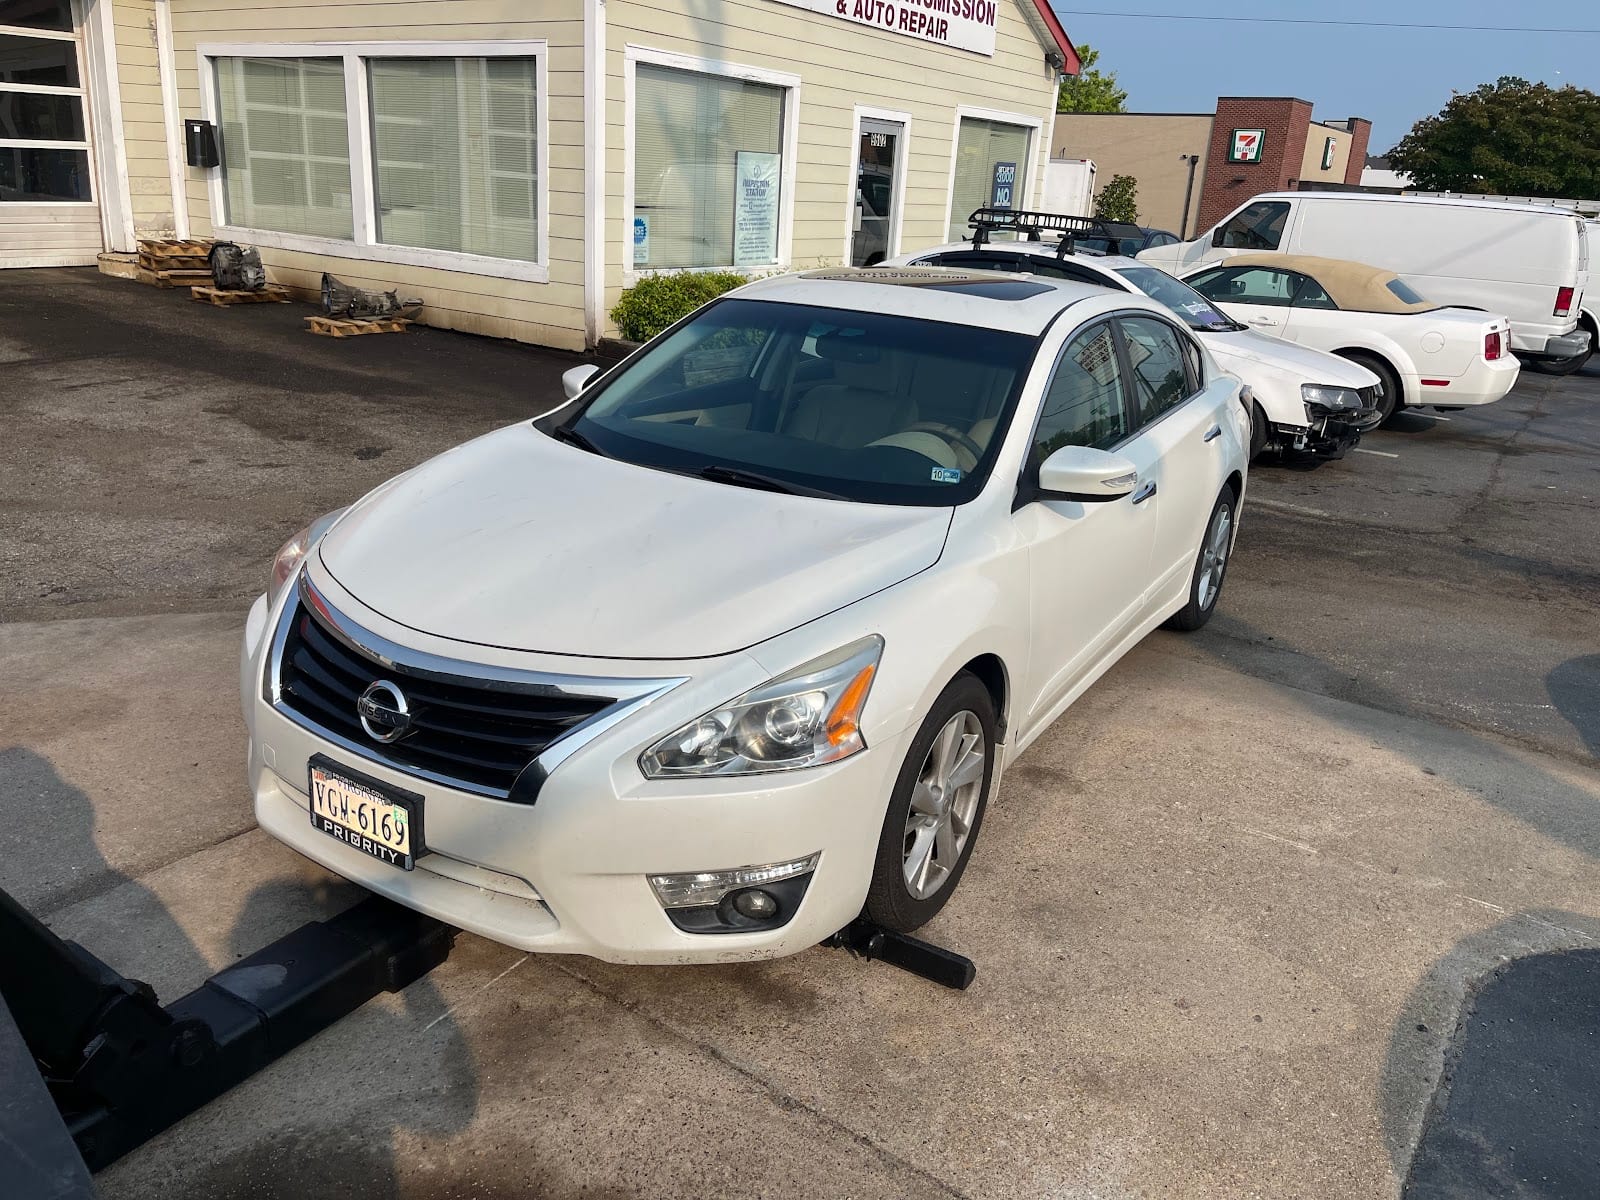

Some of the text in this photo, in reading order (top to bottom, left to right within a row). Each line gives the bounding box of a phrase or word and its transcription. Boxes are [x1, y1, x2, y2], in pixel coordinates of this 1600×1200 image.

[836, 0, 948, 41] & AUTO REPAIR
[933, 470, 943, 479] 10
[323, 819, 398, 864] PRIORITY
